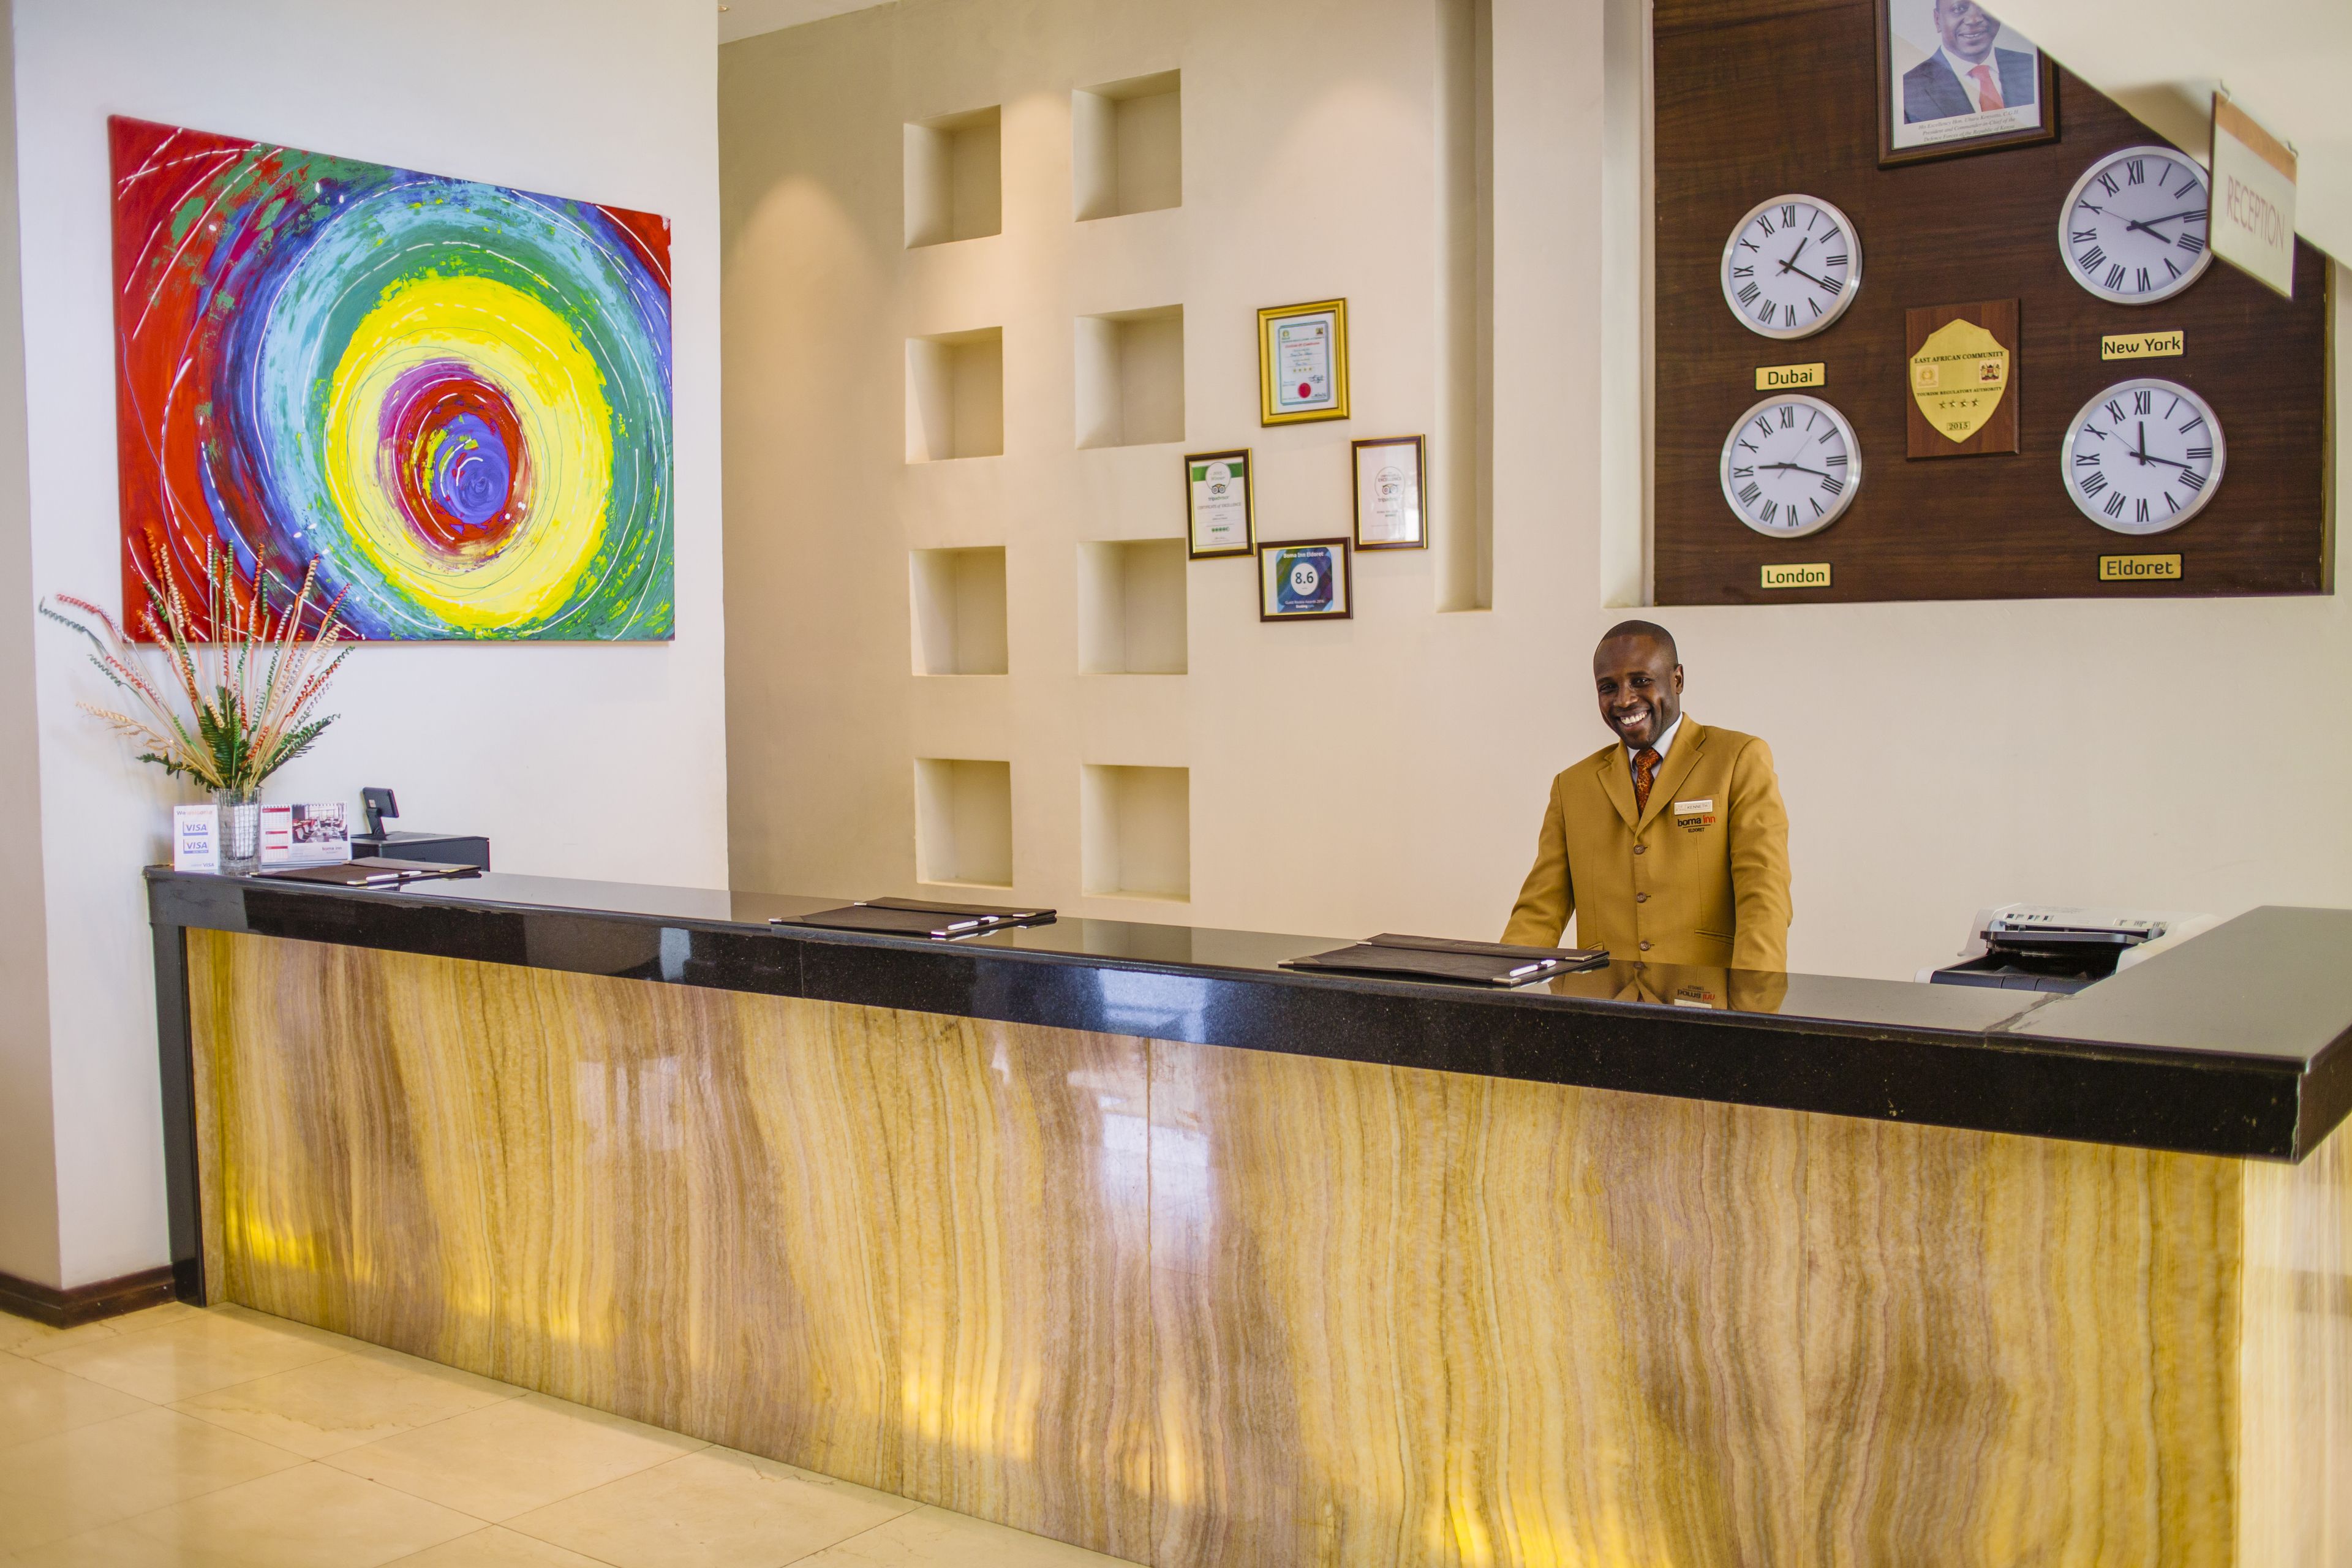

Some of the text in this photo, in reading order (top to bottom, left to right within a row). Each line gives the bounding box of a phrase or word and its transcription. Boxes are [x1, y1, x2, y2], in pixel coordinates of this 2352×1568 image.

[2127, 159, 2144, 186] XII
[2097, 172, 2120, 198] XI
[2174, 179, 2198, 200] II
[1781, 205, 1795, 228] XII
[2078, 199, 2103, 214] X
[2226, 175, 2285, 254] RECEPTION
[1757, 215, 1775, 238] XI
[1819, 227, 1839, 244] II
[2073, 228, 2097, 243] IX
[1740, 238, 1760, 253] X
[2177, 233, 2205, 254] IIII
[1826, 255, 1847, 266] III
[2078, 245, 2107, 274] VIII
[2163, 257, 2182, 279] V
[1733, 265, 1754, 277] IX
[2105, 263, 2126, 291] VII
[2136, 267, 2151, 292] VI
[1737, 281, 1761, 307] VIII
[1758, 299, 1776, 325] VII
[1785, 304, 1796, 327] VI
[1808, 297, 1822, 317] V
[1962, 351, 2004, 360] COMMUNITY
[2104, 336, 2181, 355] New York
[1768, 369, 1813, 385] Dubai
[2105, 399, 2126, 424] XI
[2134, 391, 2150, 415] XII
[1755, 416, 1773, 439] XI
[1779, 406, 1794, 429] XII
[2179, 417, 2204, 434] II
[1819, 428, 1838, 444] II
[2084, 424, 2108, 440] X
[1738, 439, 1758, 453] X
[2187, 447, 2212, 459] III
[1826, 455, 1847, 466] III
[2076, 453, 2100, 466] IX
[1733, 466, 1754, 478] IX
[2178, 469, 2207, 491] IIII
[1738, 481, 1762, 507] VIII
[1821, 475, 1844, 496] IIII
[2080, 471, 2108, 499] VIII
[1760, 499, 1777, 524] VII
[1809, 497, 1824, 517] V
[2103, 491, 2127, 518] VII
[2137, 498, 2149, 522] VI
[2164, 491, 2180, 514] V
[1787, 505, 1798, 526] VI
[1295, 571, 1314, 584] 8.6
[1767, 568, 1825, 584] London
[2106, 560, 2174, 576] Eldoret
[1677, 815, 1716, 827] boma inn
